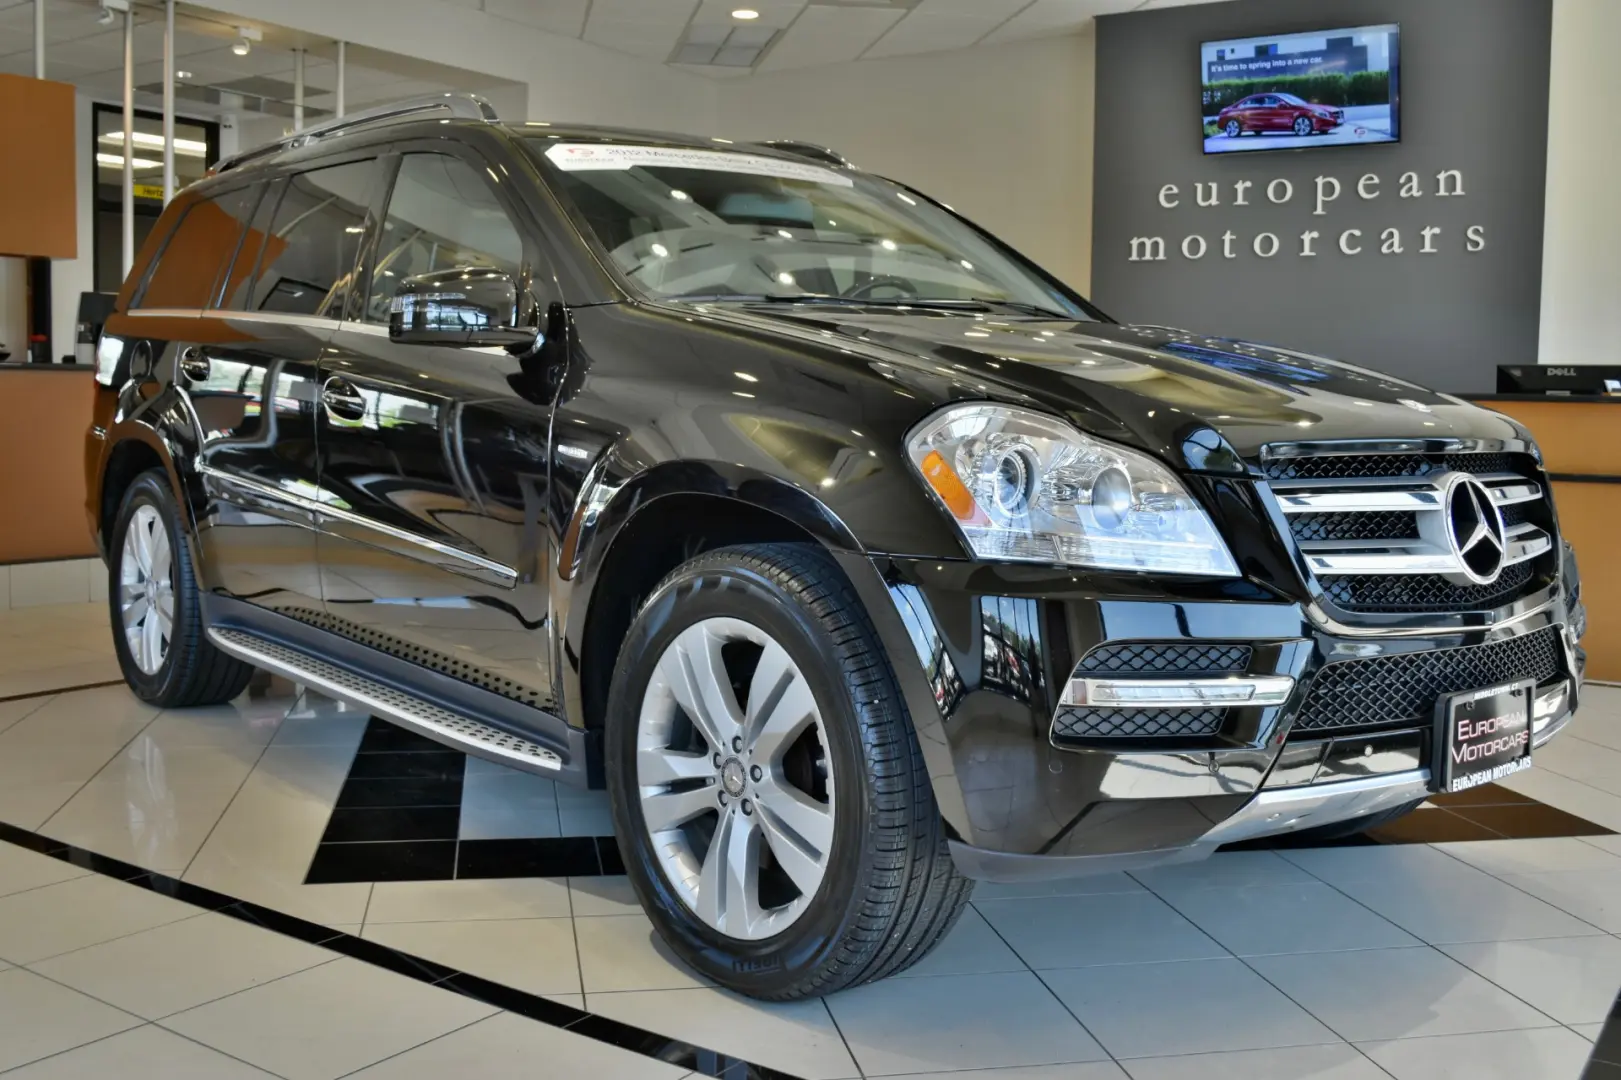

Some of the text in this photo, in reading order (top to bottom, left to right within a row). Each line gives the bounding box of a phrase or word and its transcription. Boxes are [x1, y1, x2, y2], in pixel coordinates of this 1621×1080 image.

[1211, 65, 1222, 73] It's
[1223, 63, 1239, 72] time
[1239, 63, 1248, 71] to
[1248, 60, 1271, 71] spring
[1272, 59, 1286, 68] into
[1294, 57, 1309, 65] new
[142, 187, 164, 197] Hertz
[1158, 168, 1466, 215] european
[1128, 224, 1486, 262] motorcars
[1546, 367, 1577, 376] DELL
[1458, 711, 1526, 741] EUROPEAN
[1451, 730, 1529, 764] MOTORCARS
